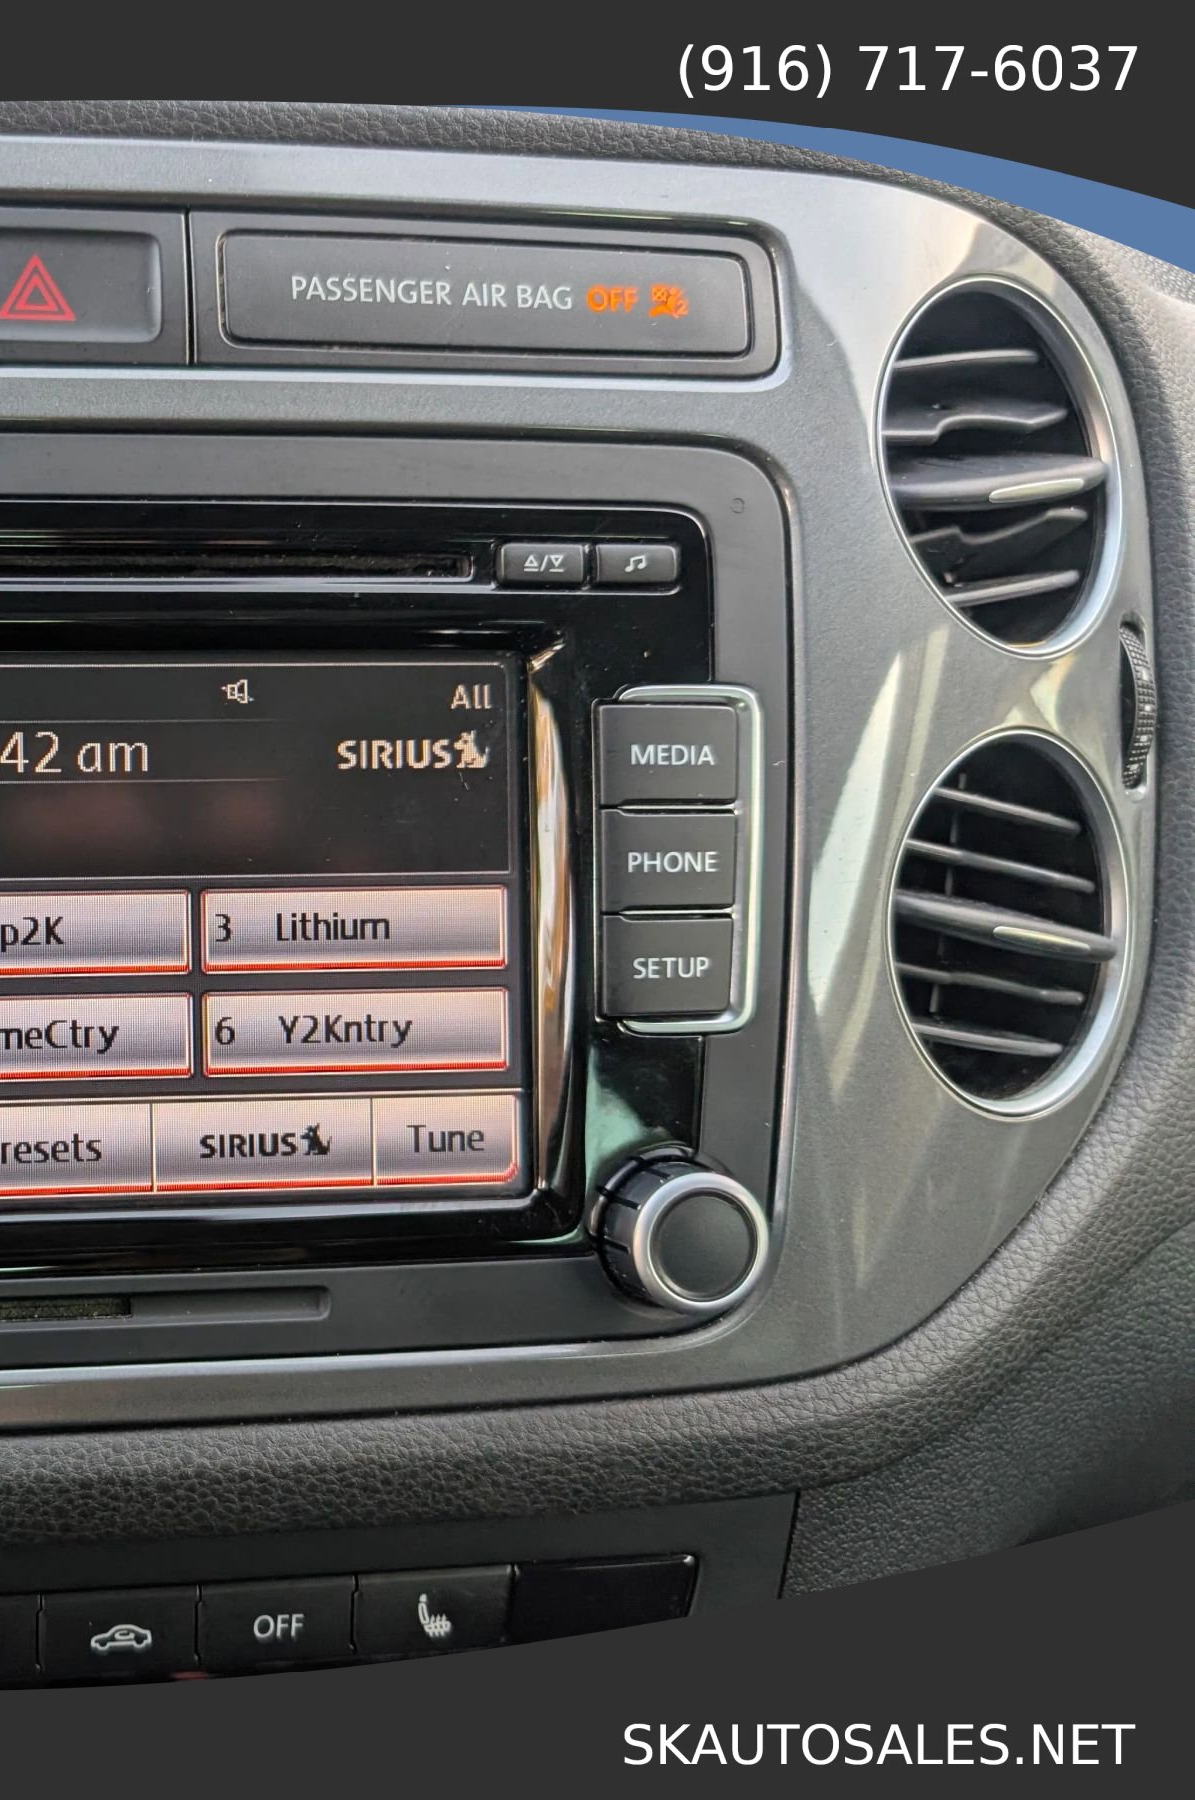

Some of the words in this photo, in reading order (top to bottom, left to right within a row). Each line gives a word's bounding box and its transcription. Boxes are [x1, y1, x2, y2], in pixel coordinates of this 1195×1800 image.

[290, 275, 453, 306] PASSENGER
[462, 281, 507, 308] AIR
[516, 285, 573, 311] BAG
[586, 284, 639, 313] OFF
[450, 683, 493, 710] All
[76, 739, 150, 774] am
[337, 738, 453, 771] SIRIUS
[629, 743, 716, 766] MEDIA
[627, 850, 720, 874] PHONE
[214, 912, 233, 944] 3
[276, 911, 391, 942] Lithium
[632, 956, 711, 980] SETUP
[214, 1016, 236, 1046] 6
[278, 1013, 414, 1049] Y2Kntry
[199, 1132, 299, 1160] SIRIUS
[406, 1123, 486, 1154] Tune
[252, 1613, 304, 1640] OFF
